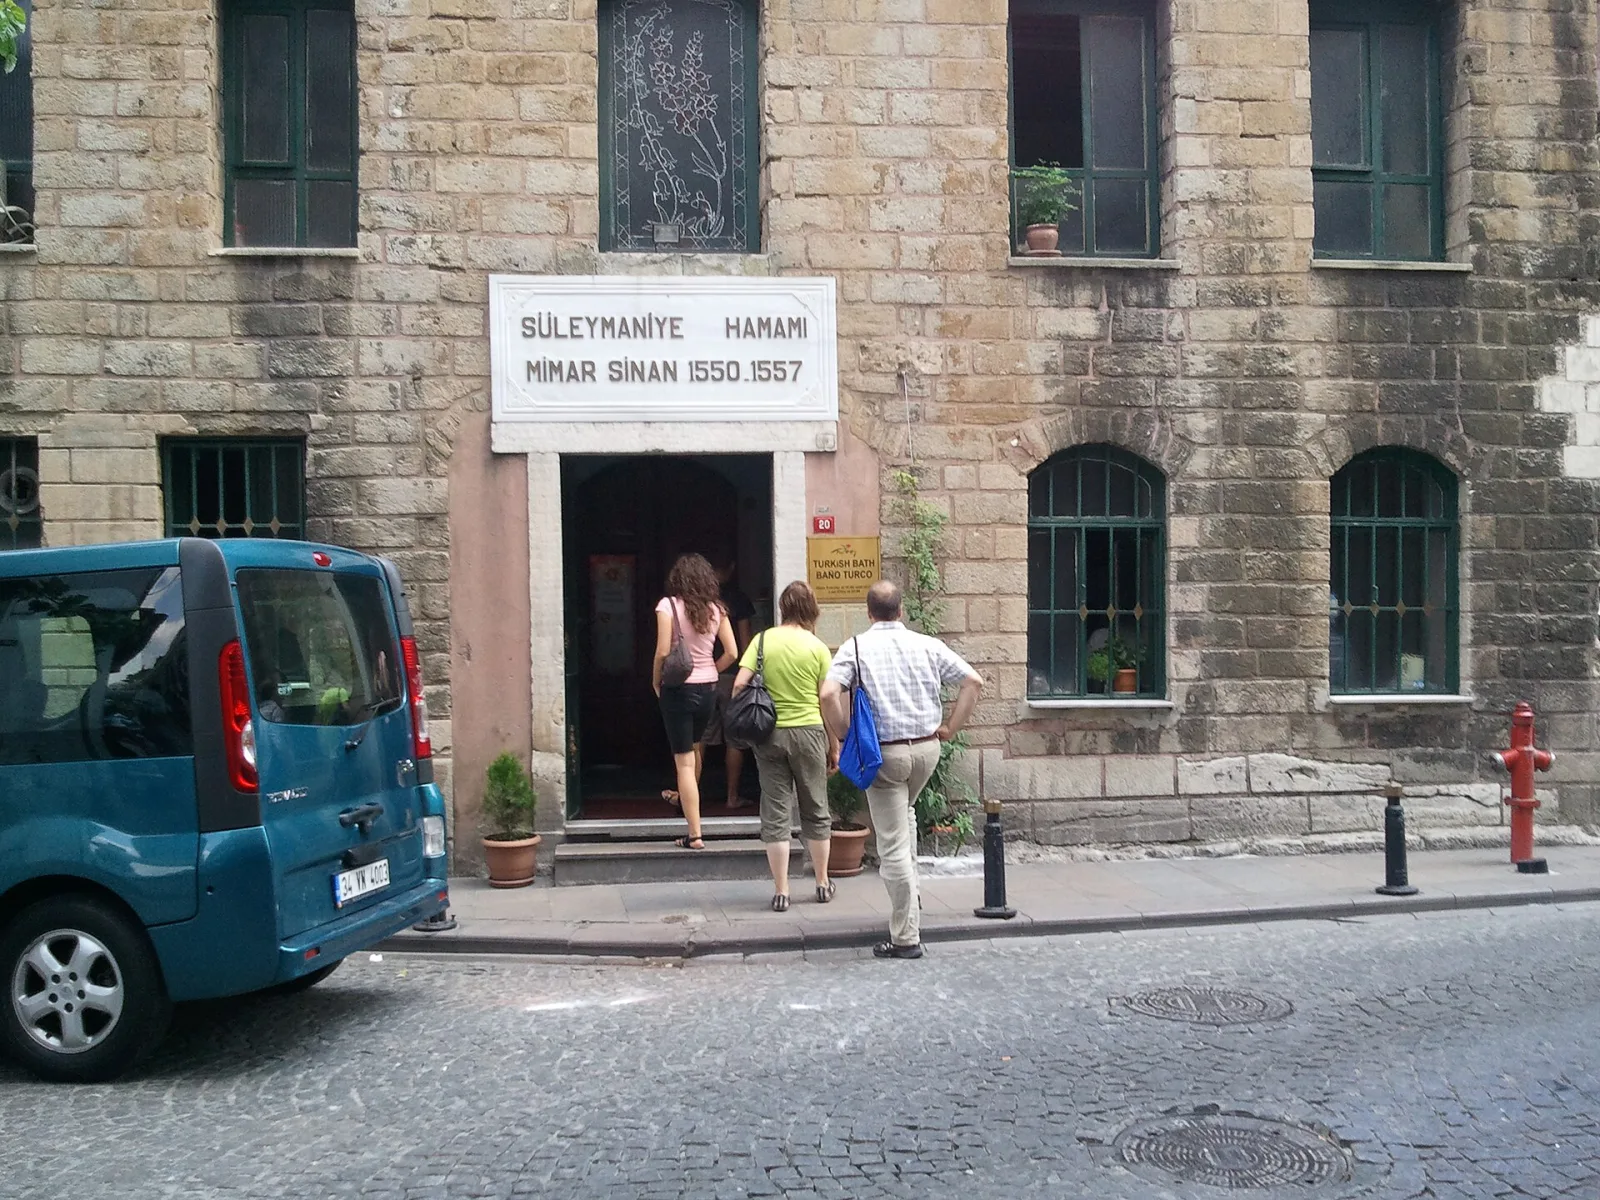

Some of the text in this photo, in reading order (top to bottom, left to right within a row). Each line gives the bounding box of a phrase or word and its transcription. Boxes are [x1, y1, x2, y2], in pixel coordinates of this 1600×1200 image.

[521, 311, 808, 339] SÜLEYMANİYE HAMAMI
[526, 356, 597, 383] MİMAR
[608, 356, 678, 383] SİNAN
[818, 519, 831, 530] 20
[852, 559, 875, 568] BATH
[843, 570, 873, 579] TURCO
[341, 875, 353, 897] 34
